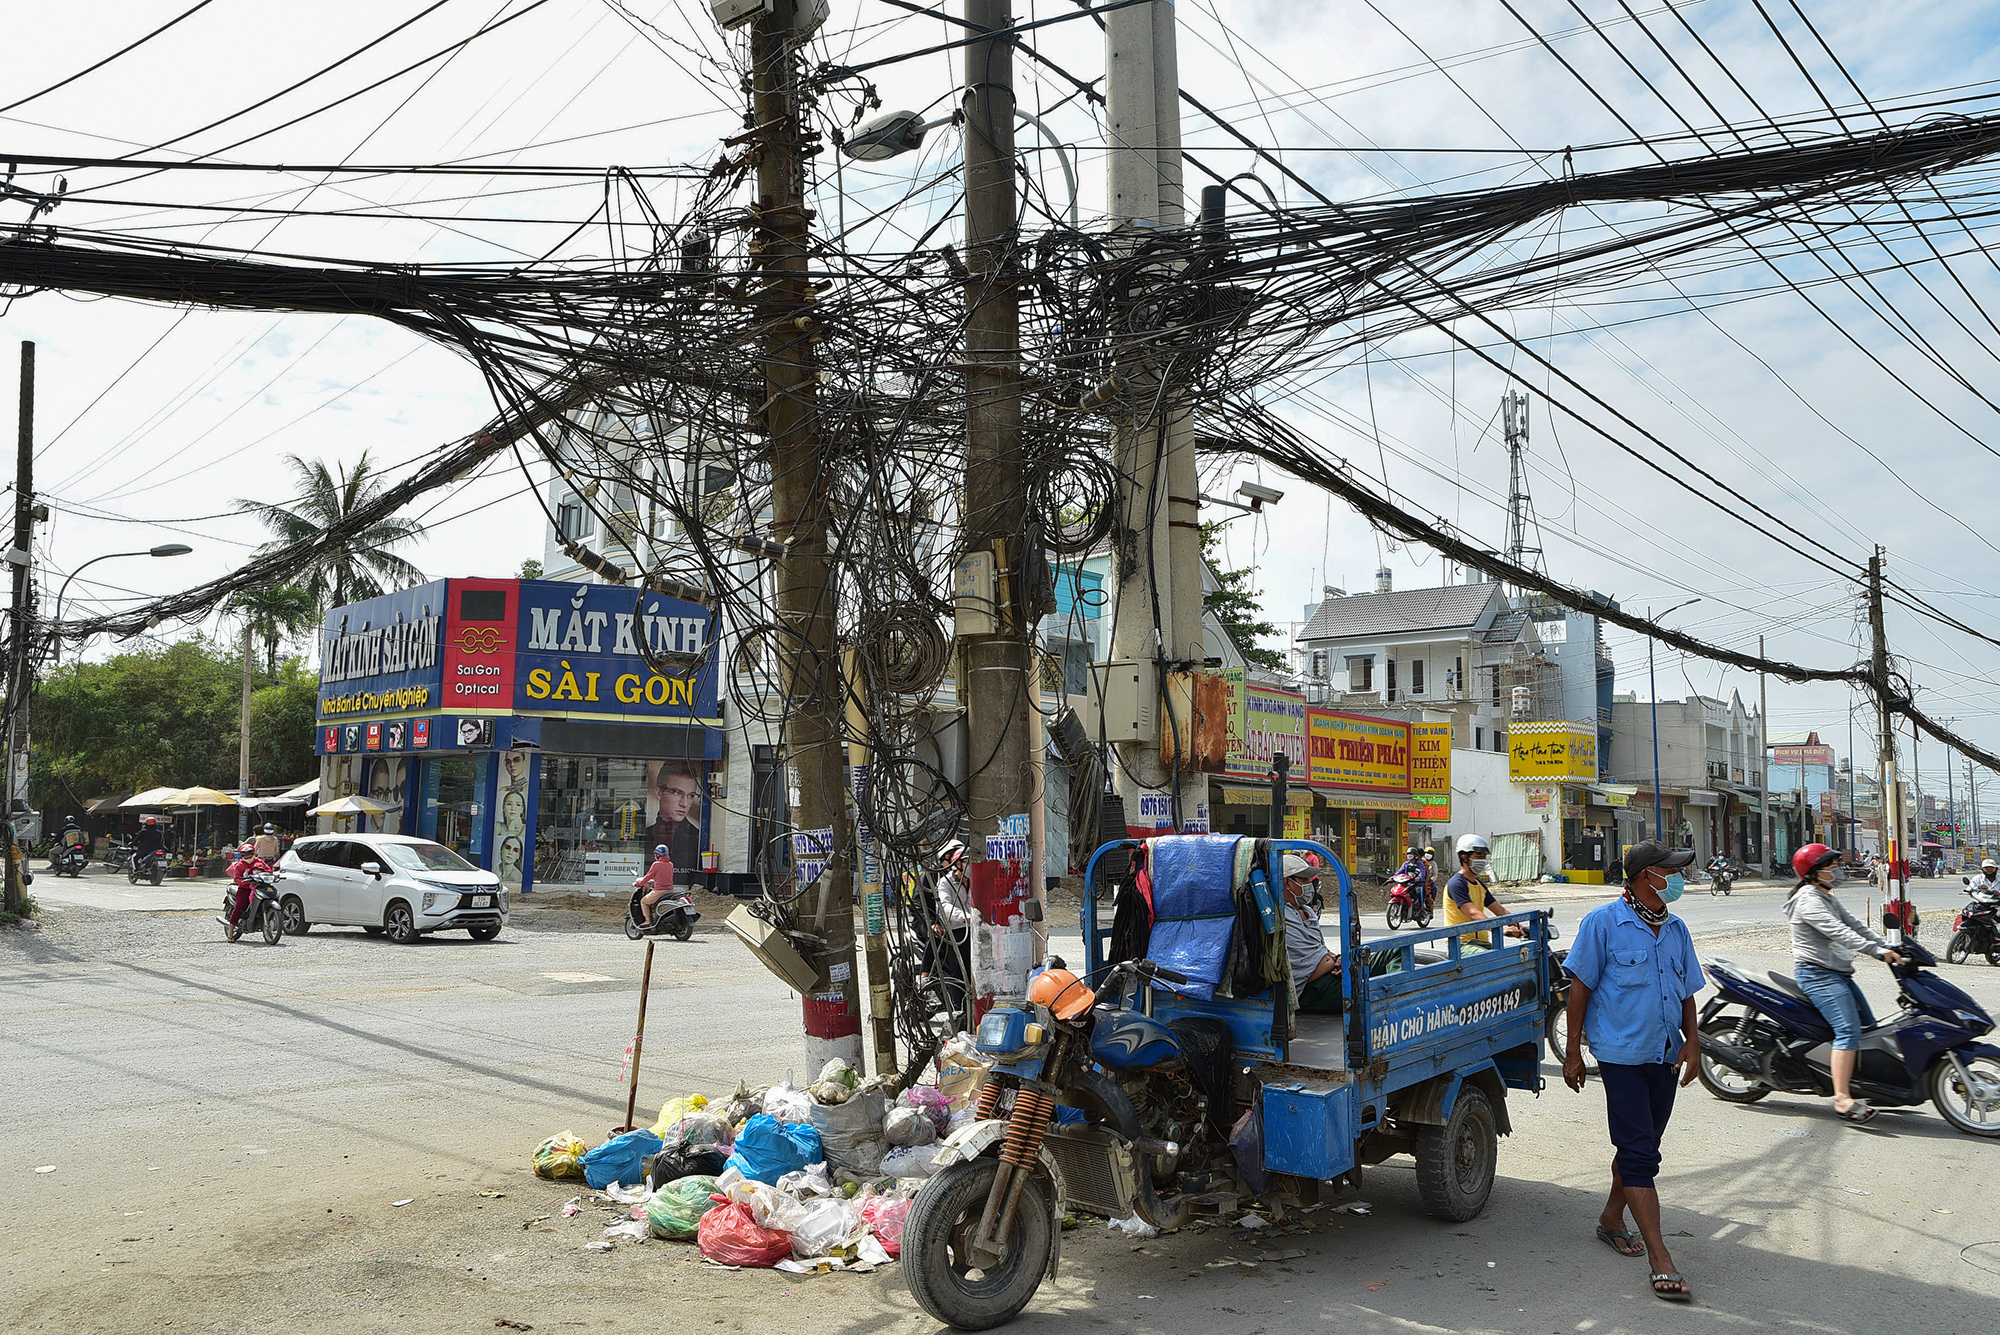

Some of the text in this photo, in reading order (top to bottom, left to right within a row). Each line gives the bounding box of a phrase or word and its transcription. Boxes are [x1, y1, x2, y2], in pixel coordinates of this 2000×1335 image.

[528, 585, 706, 655] MẮT KÍNH
[457, 664, 500, 676] SaiGon
[455, 683, 499, 696] Optical
[526, 660, 696, 706] SÀI GÒN
[321, 694, 337, 715] Nhà
[337, 692, 351, 713] Bán
[362, 690, 395, 712] Chuyên
[396, 685, 428, 710] Nghiệp
[1287, 700, 1304, 719] VÀNG
[1412, 724, 1448, 737] TIỆM VÀNG
[1311, 735, 1406, 767] KIM THIỆN PHÁT
[1418, 740, 1441, 752] KIM
[1412, 754, 1447, 773] THIỆN
[1413, 774, 1445, 789] PHÁT
[1141, 798, 1157, 815] 0976
[986, 841, 1026, 860] 0976 150 170
